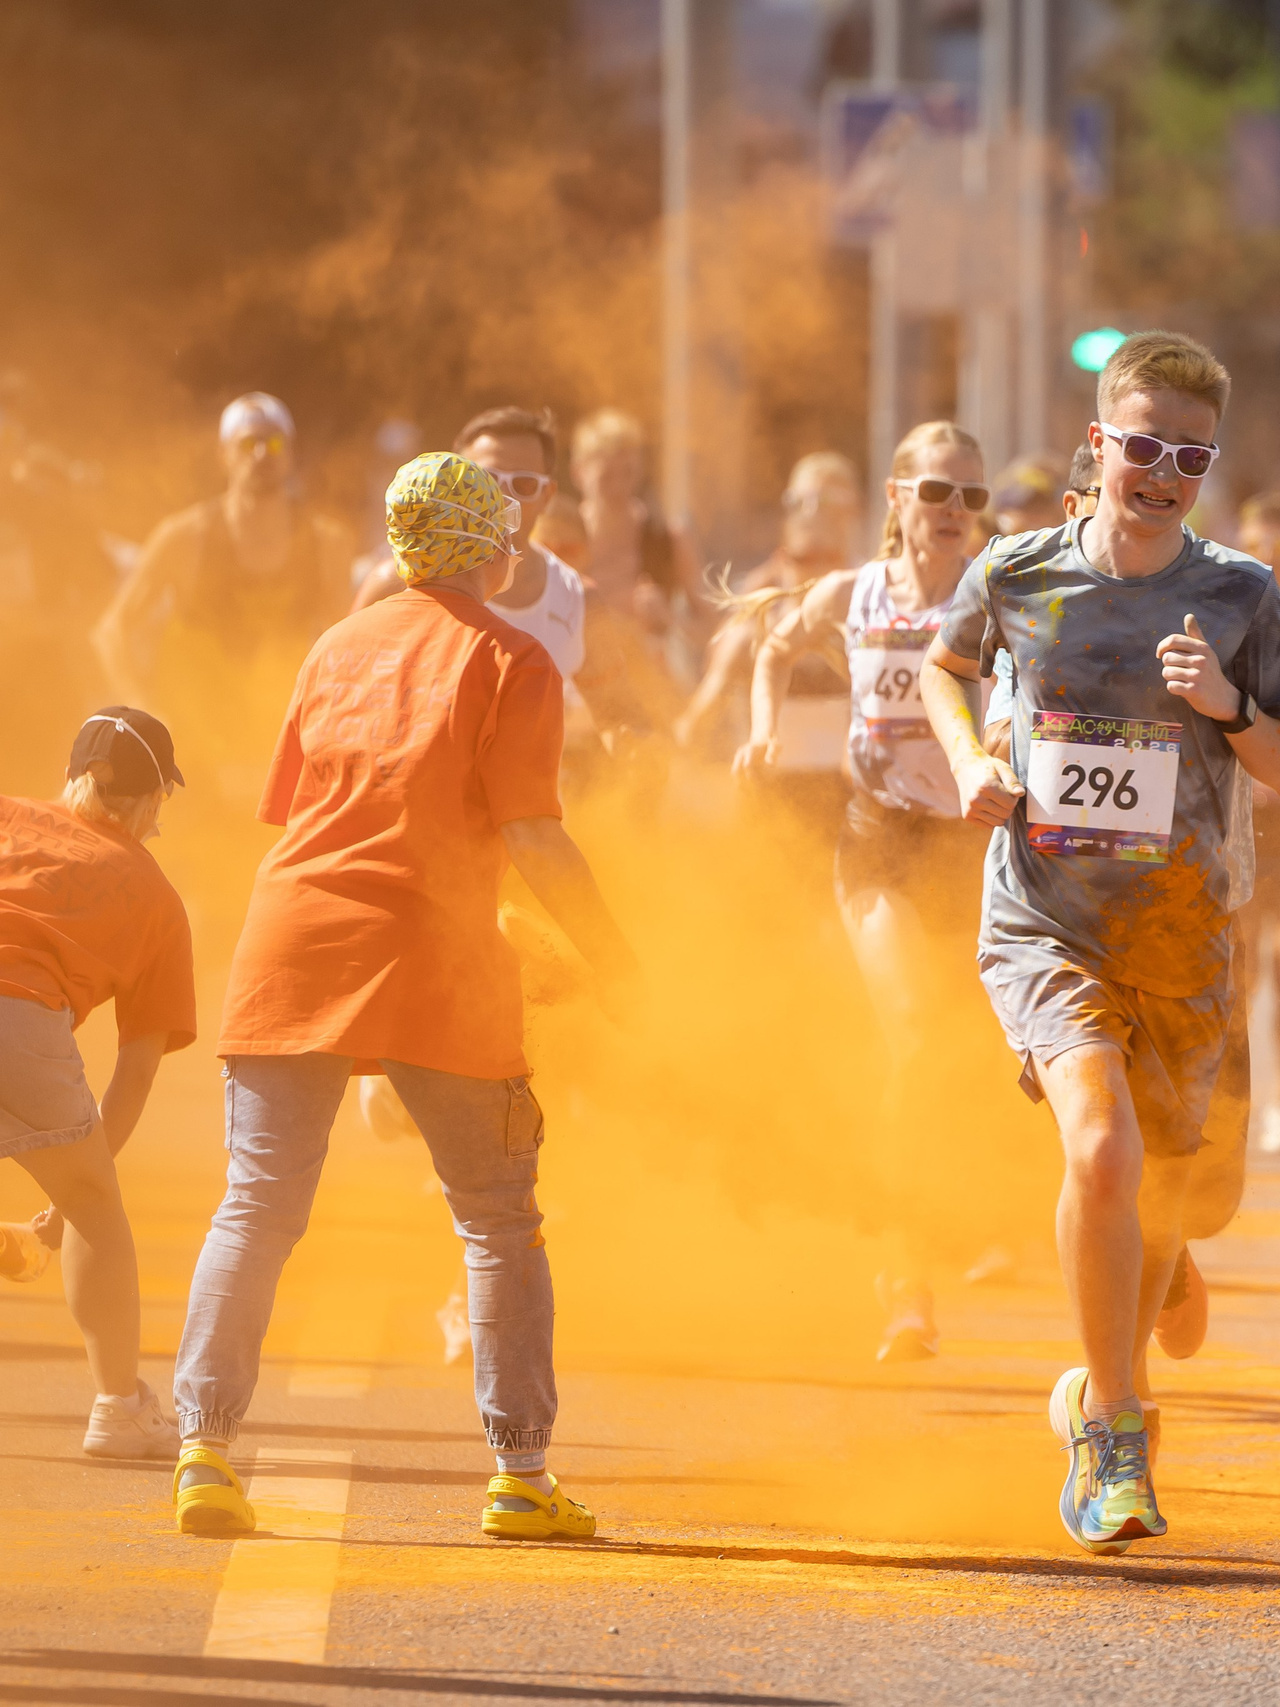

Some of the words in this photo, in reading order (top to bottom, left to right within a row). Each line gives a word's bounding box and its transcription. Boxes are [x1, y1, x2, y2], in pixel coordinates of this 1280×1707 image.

[1042, 715, 1169, 741] КРАСОЧНЫЙ
[1113, 738, 1177, 753] 2026
[1059, 764, 1139, 811] 296
